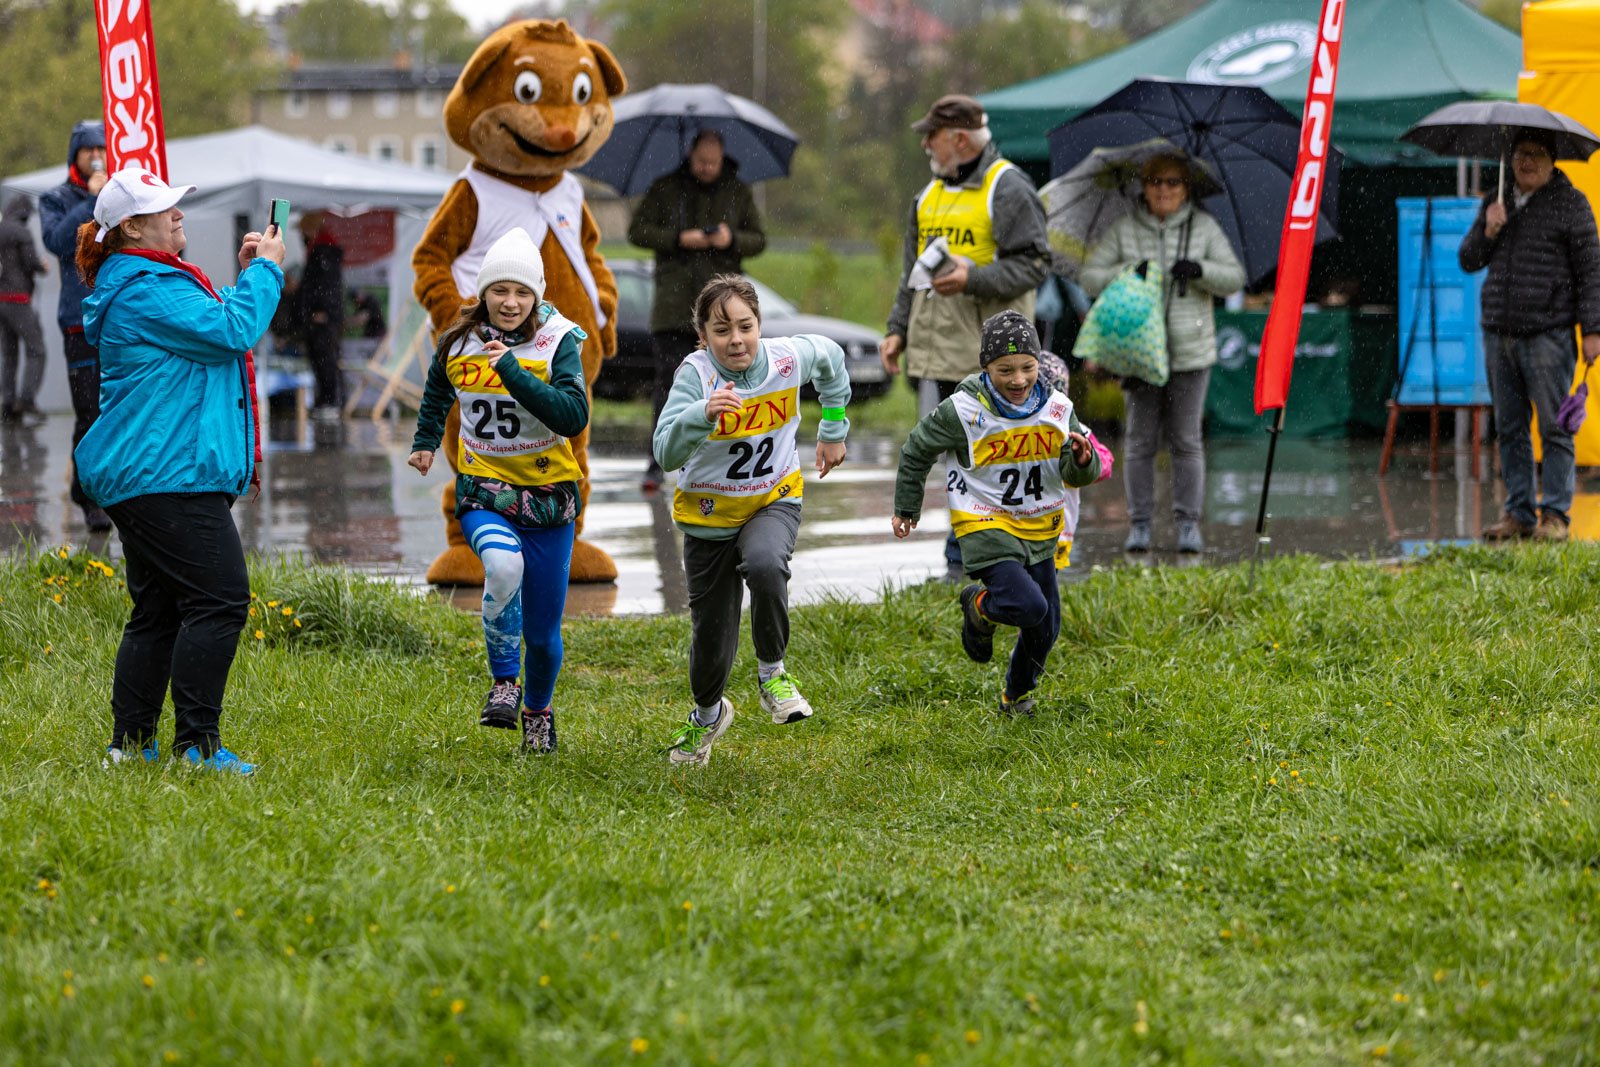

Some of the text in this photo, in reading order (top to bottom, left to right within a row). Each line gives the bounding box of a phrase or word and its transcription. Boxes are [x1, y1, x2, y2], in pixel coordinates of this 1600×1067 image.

[472, 399, 521, 440] 25
[717, 396, 789, 436] DZN
[726, 436, 774, 480] 22
[987, 431, 1055, 462] DZN
[947, 470, 968, 495] 24
[1000, 465, 1044, 506] 24
